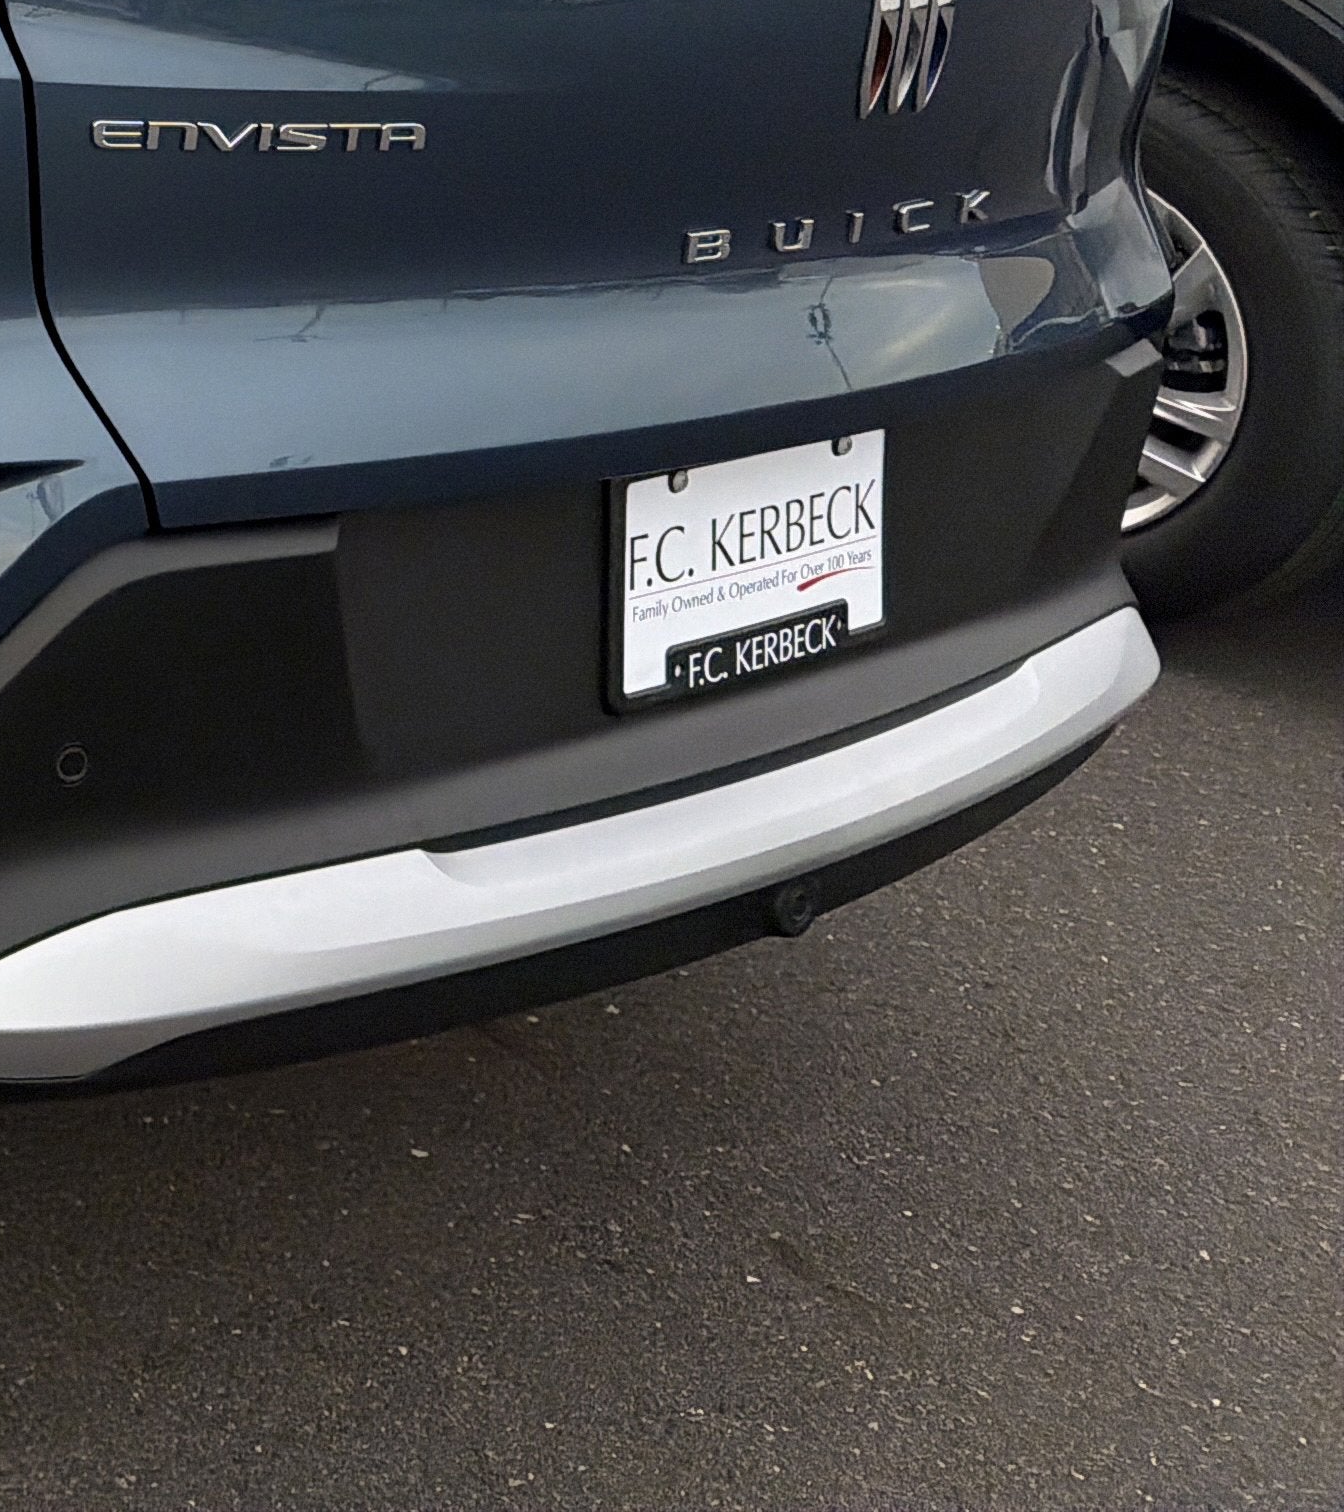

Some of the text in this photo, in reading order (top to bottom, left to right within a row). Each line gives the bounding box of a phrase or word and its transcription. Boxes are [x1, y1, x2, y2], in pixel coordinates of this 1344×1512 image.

[92, 120, 427, 152] ENVISTA
[684, 188, 991, 265] BUICK
[629, 478, 876, 591] F.C. KERBECK
[632, 549, 872, 623] Family Owned & Operated For Over 100 Years
[688, 614, 837, 689] F.C. KERBECK
